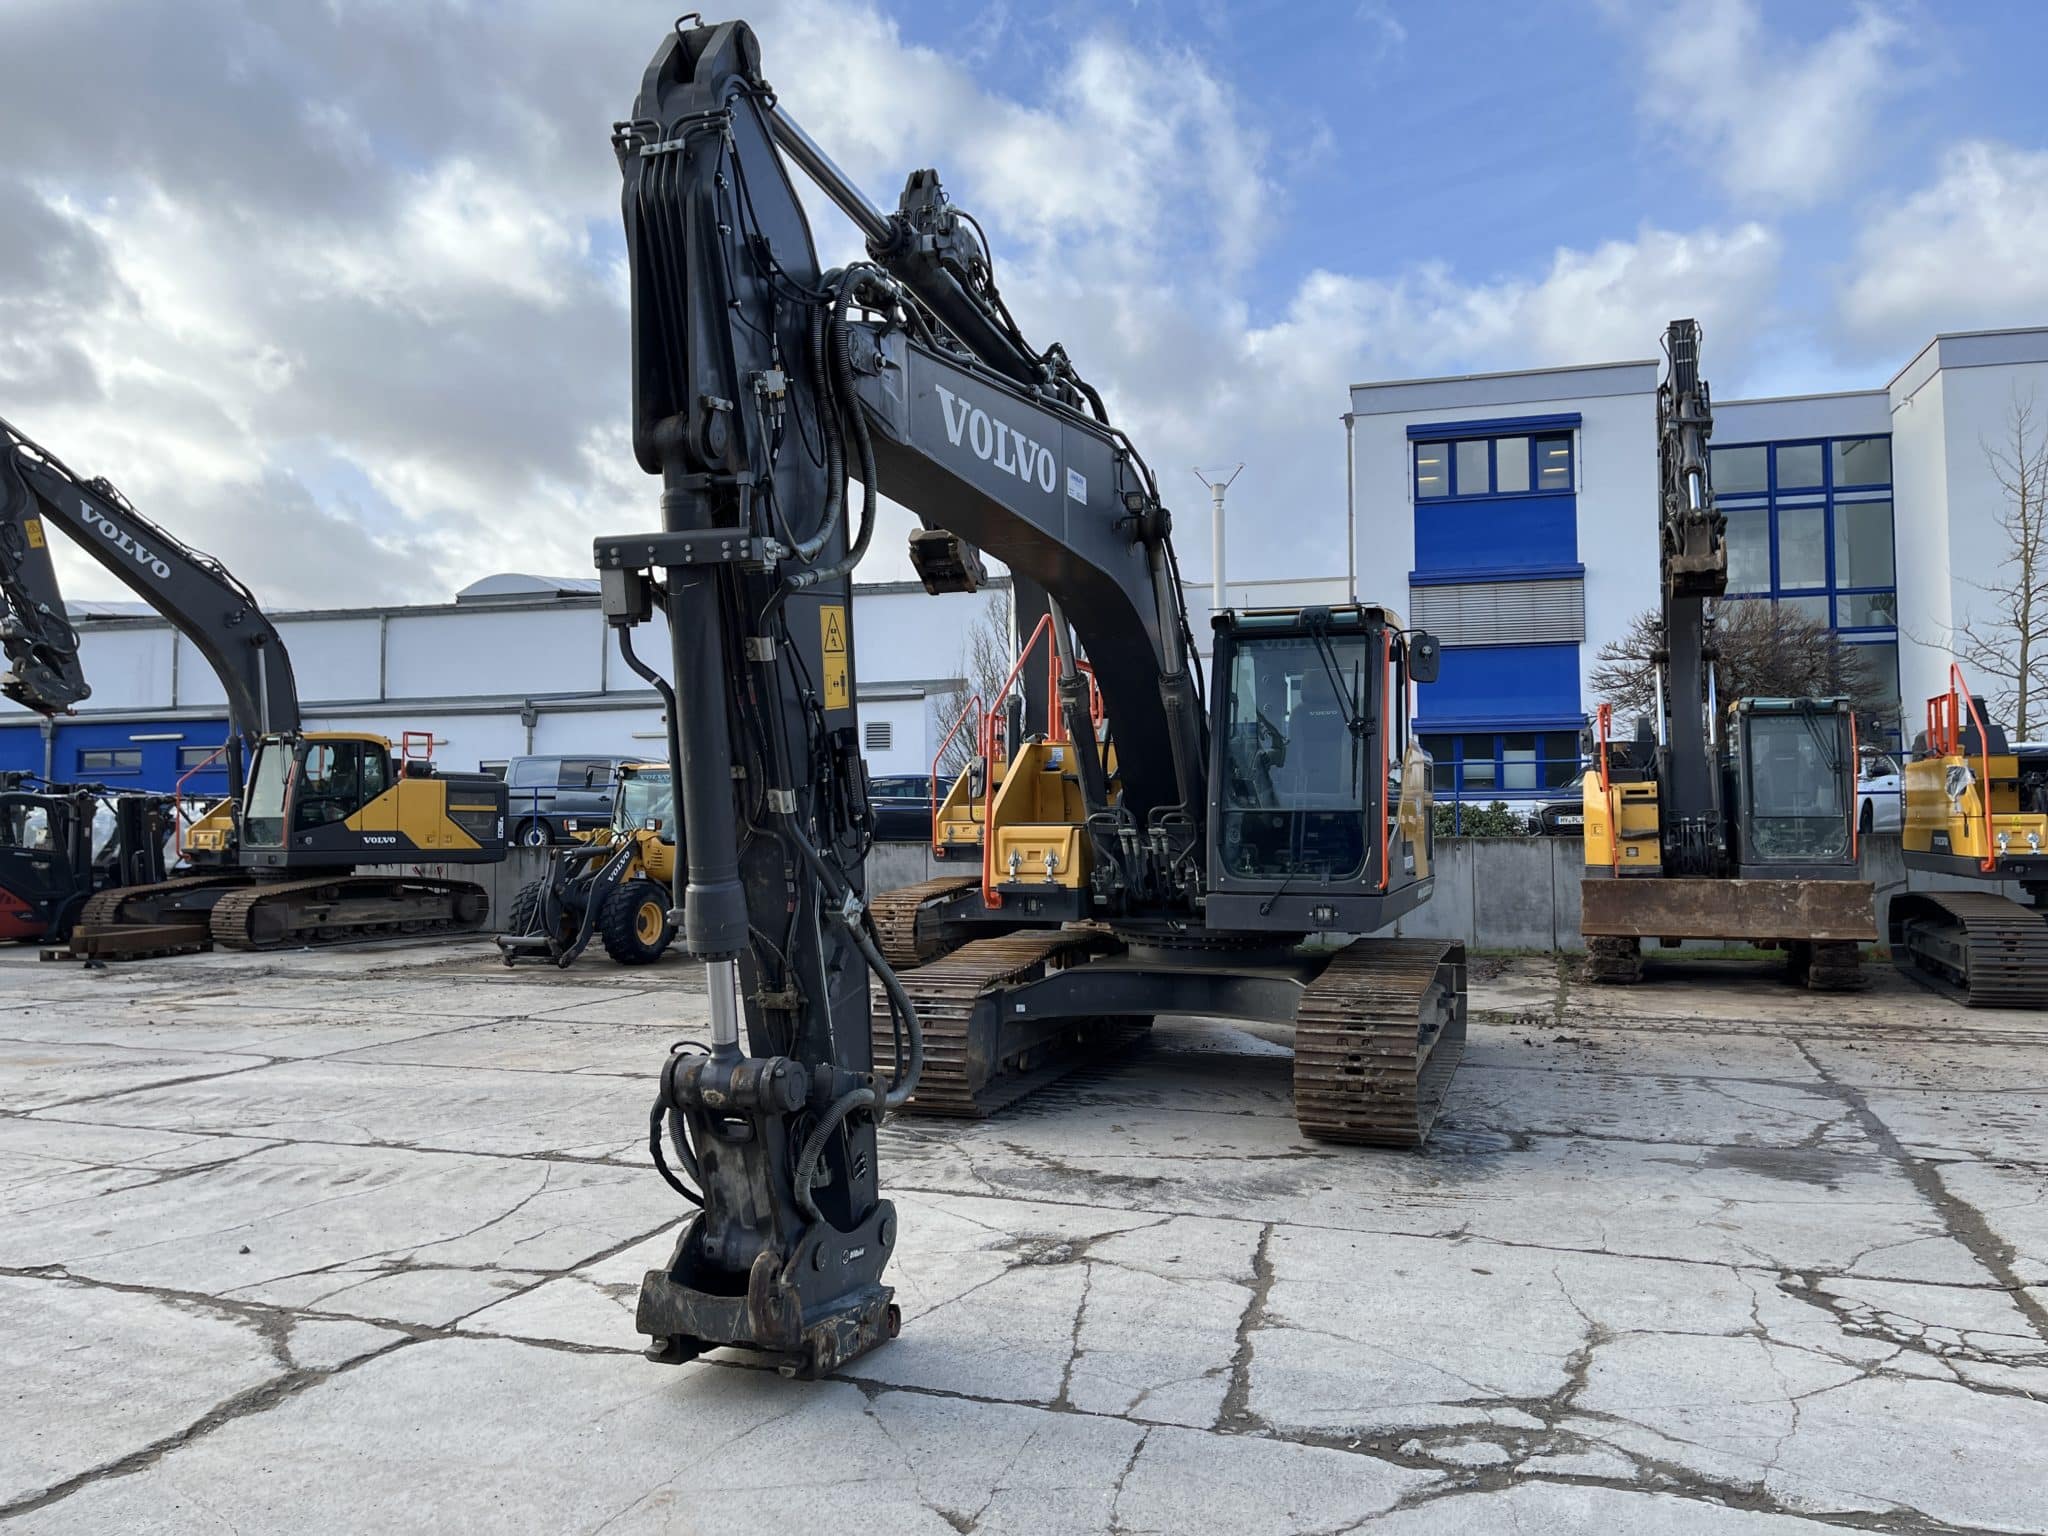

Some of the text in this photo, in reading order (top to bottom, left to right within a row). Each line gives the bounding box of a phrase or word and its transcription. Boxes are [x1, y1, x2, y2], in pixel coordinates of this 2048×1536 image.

[935, 384, 1057, 494] VOLVO
[80, 499, 171, 579] VOLVO
[363, 836, 396, 844] VOLVO
[607, 850, 631, 883] VOLVO
